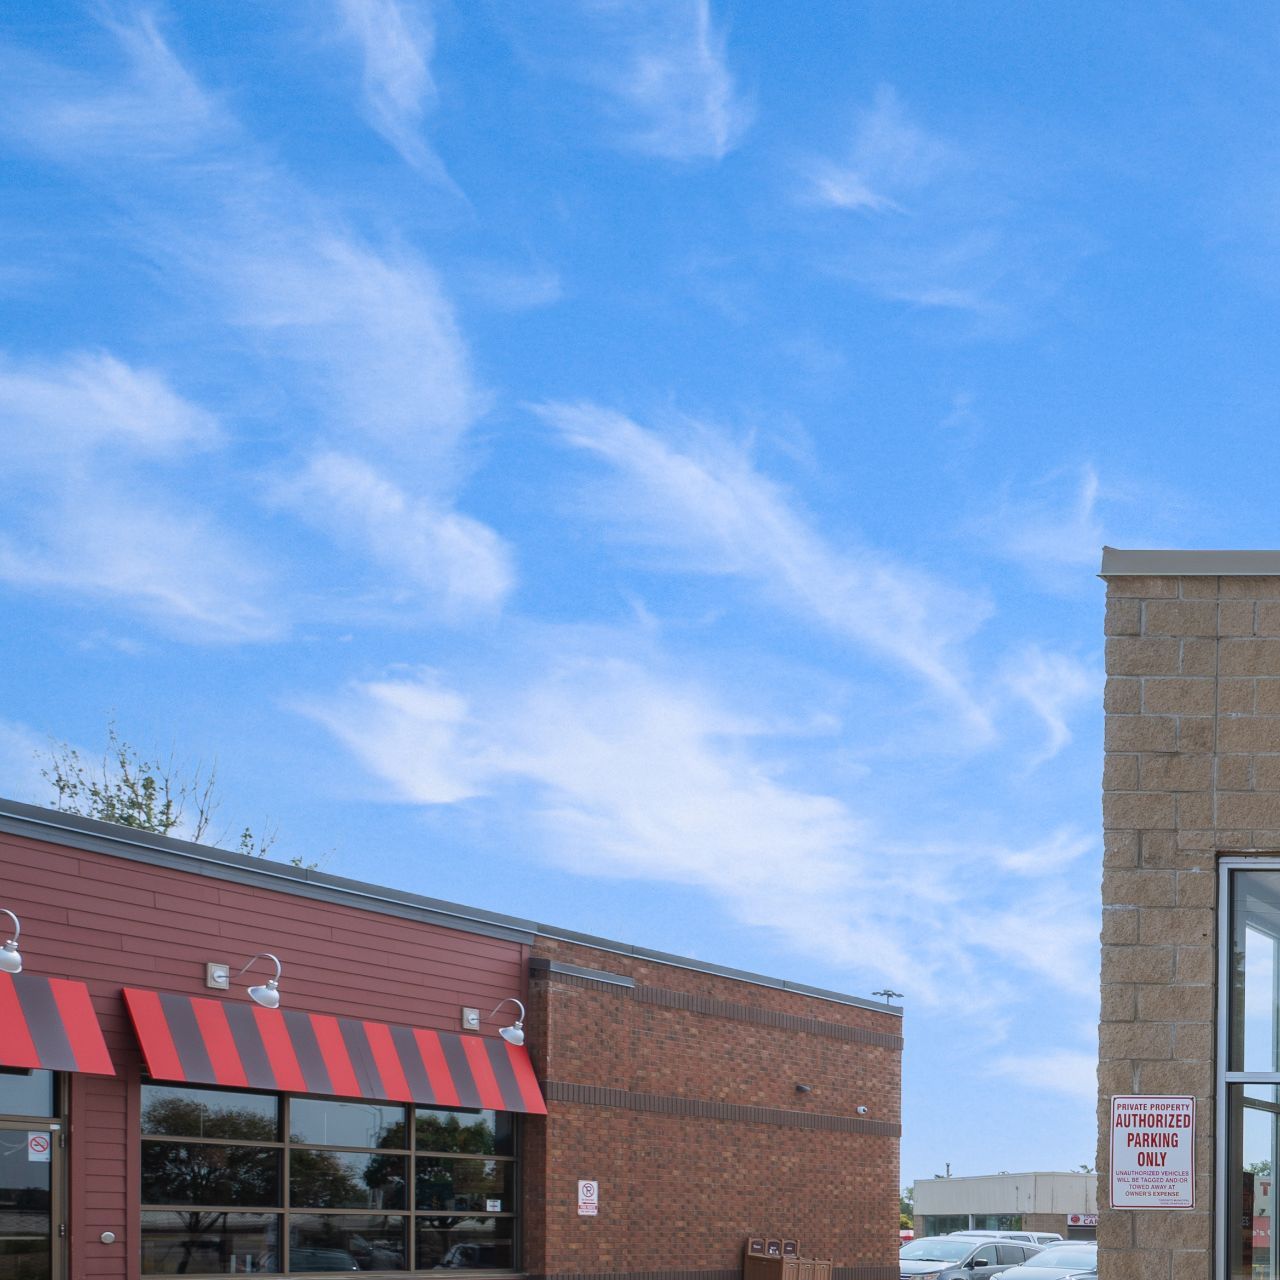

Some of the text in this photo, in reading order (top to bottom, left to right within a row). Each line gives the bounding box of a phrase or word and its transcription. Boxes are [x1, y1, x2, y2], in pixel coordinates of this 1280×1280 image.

[1117, 1103, 1190, 1111] PRIVATE PROPERTY
[1115, 1114, 1191, 1128] AUTHORIZED
[1127, 1132, 1178, 1148] PARKING
[1137, 1152, 1167, 1167] ONLY
